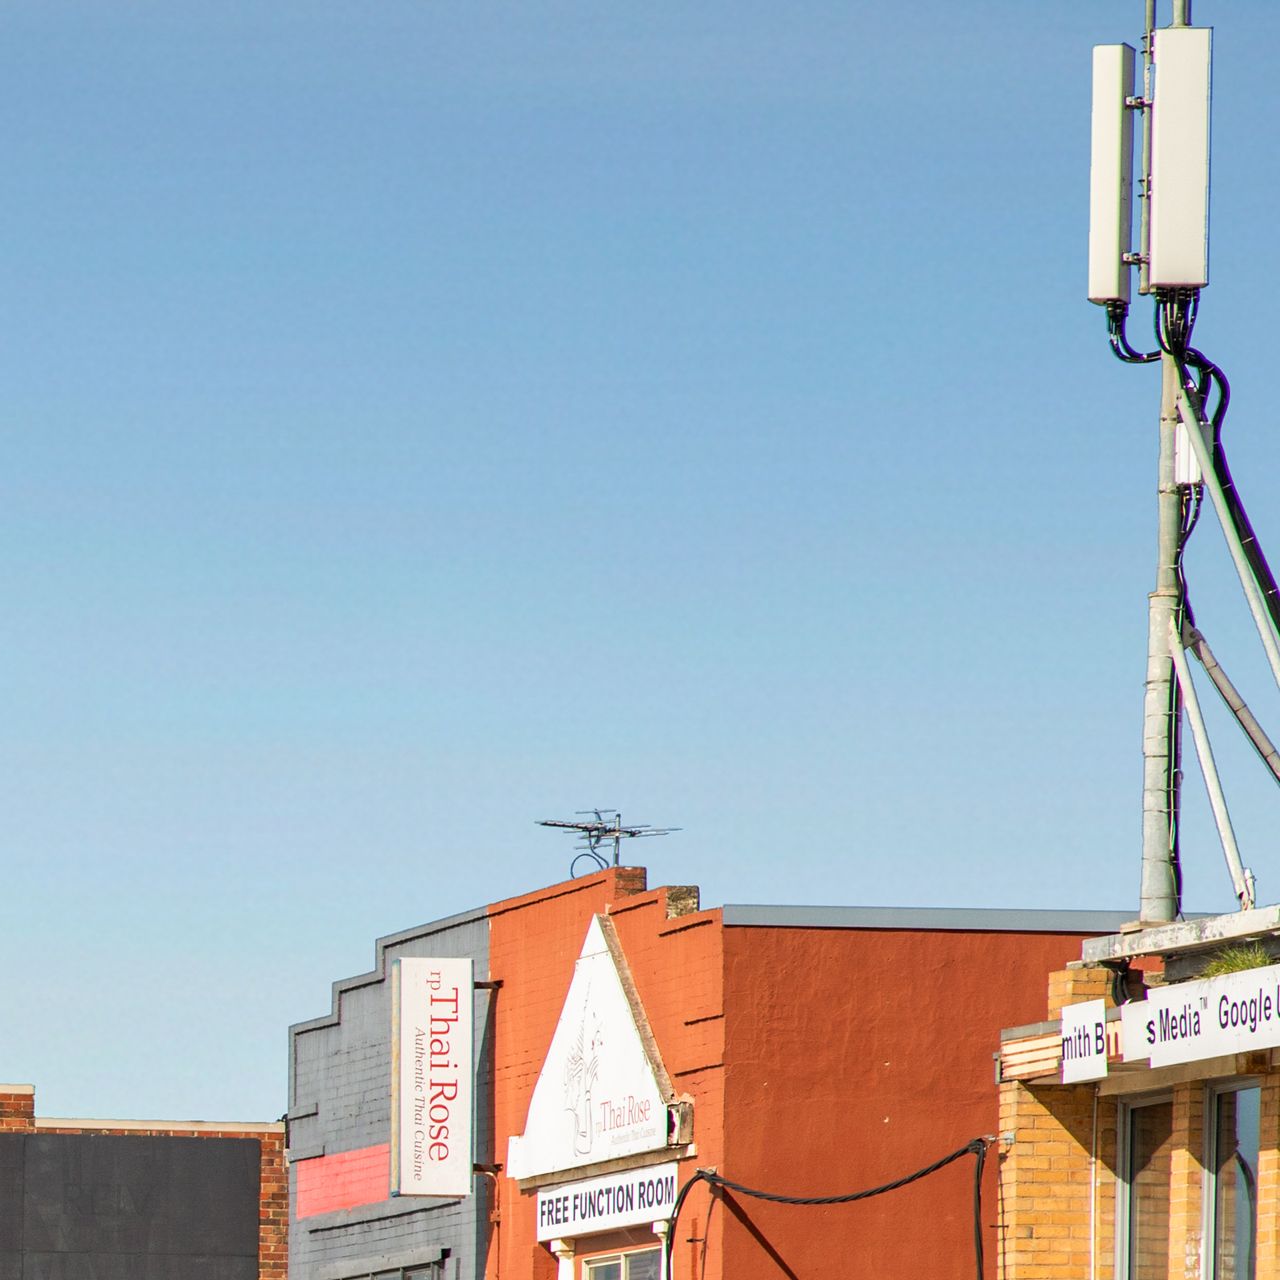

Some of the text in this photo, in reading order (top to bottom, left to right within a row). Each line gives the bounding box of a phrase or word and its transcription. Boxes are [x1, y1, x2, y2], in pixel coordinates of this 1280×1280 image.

[429, 987, 459, 1070] Thai
[1218, 994, 1272, 1034] Google
[414, 1026, 426, 1181] Authentic Thai Cuisine
[429, 1078, 458, 1162] Rose
[600, 1096, 626, 1131] Thai
[627, 1095, 651, 1125] Rose
[540, 1175, 675, 1227] FREE FUNCTION ROOM
